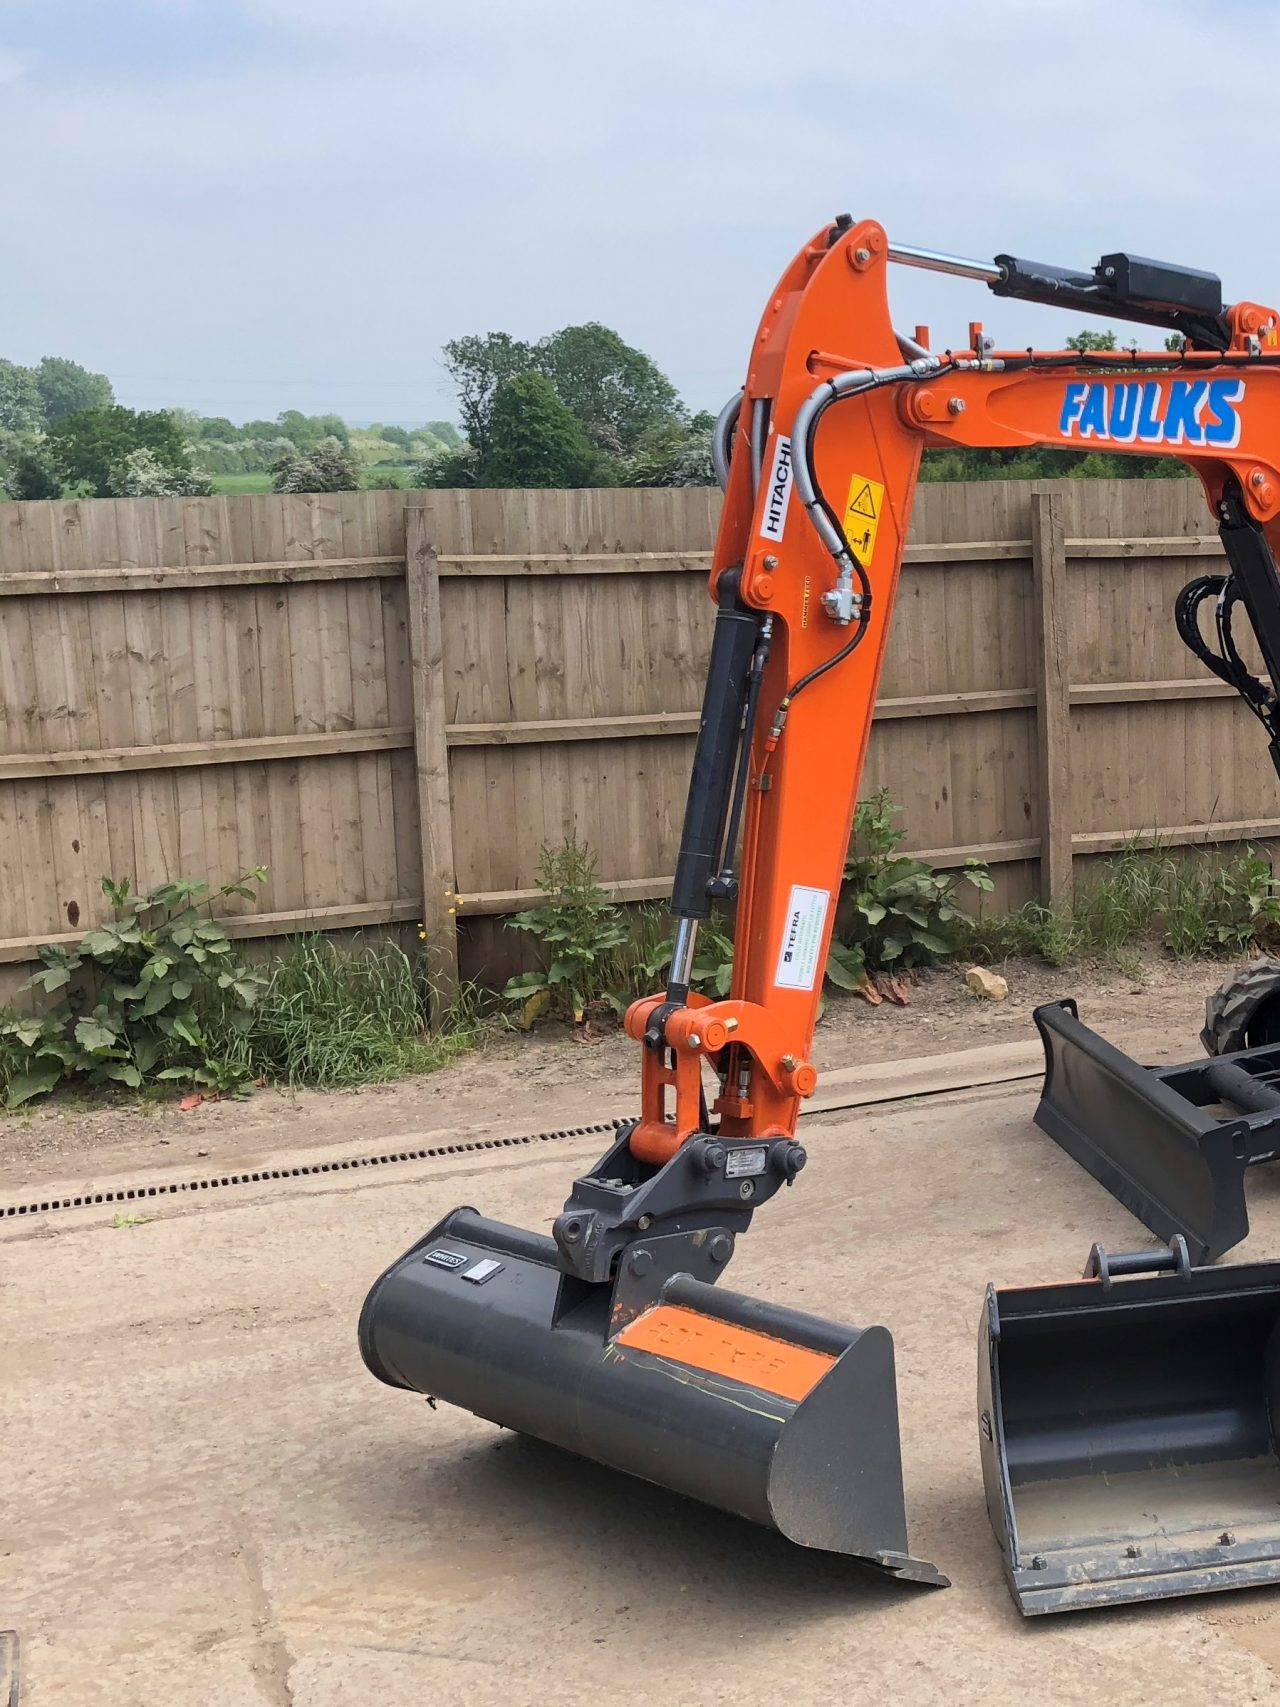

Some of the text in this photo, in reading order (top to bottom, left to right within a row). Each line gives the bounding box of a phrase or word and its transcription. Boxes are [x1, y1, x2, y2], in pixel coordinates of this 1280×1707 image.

[1059, 379, 1246, 449] FAULKS
[767, 443, 792, 533] HITACHI
[788, 911, 801, 949] TEFRA
[430, 1252, 462, 1265] WHITES
